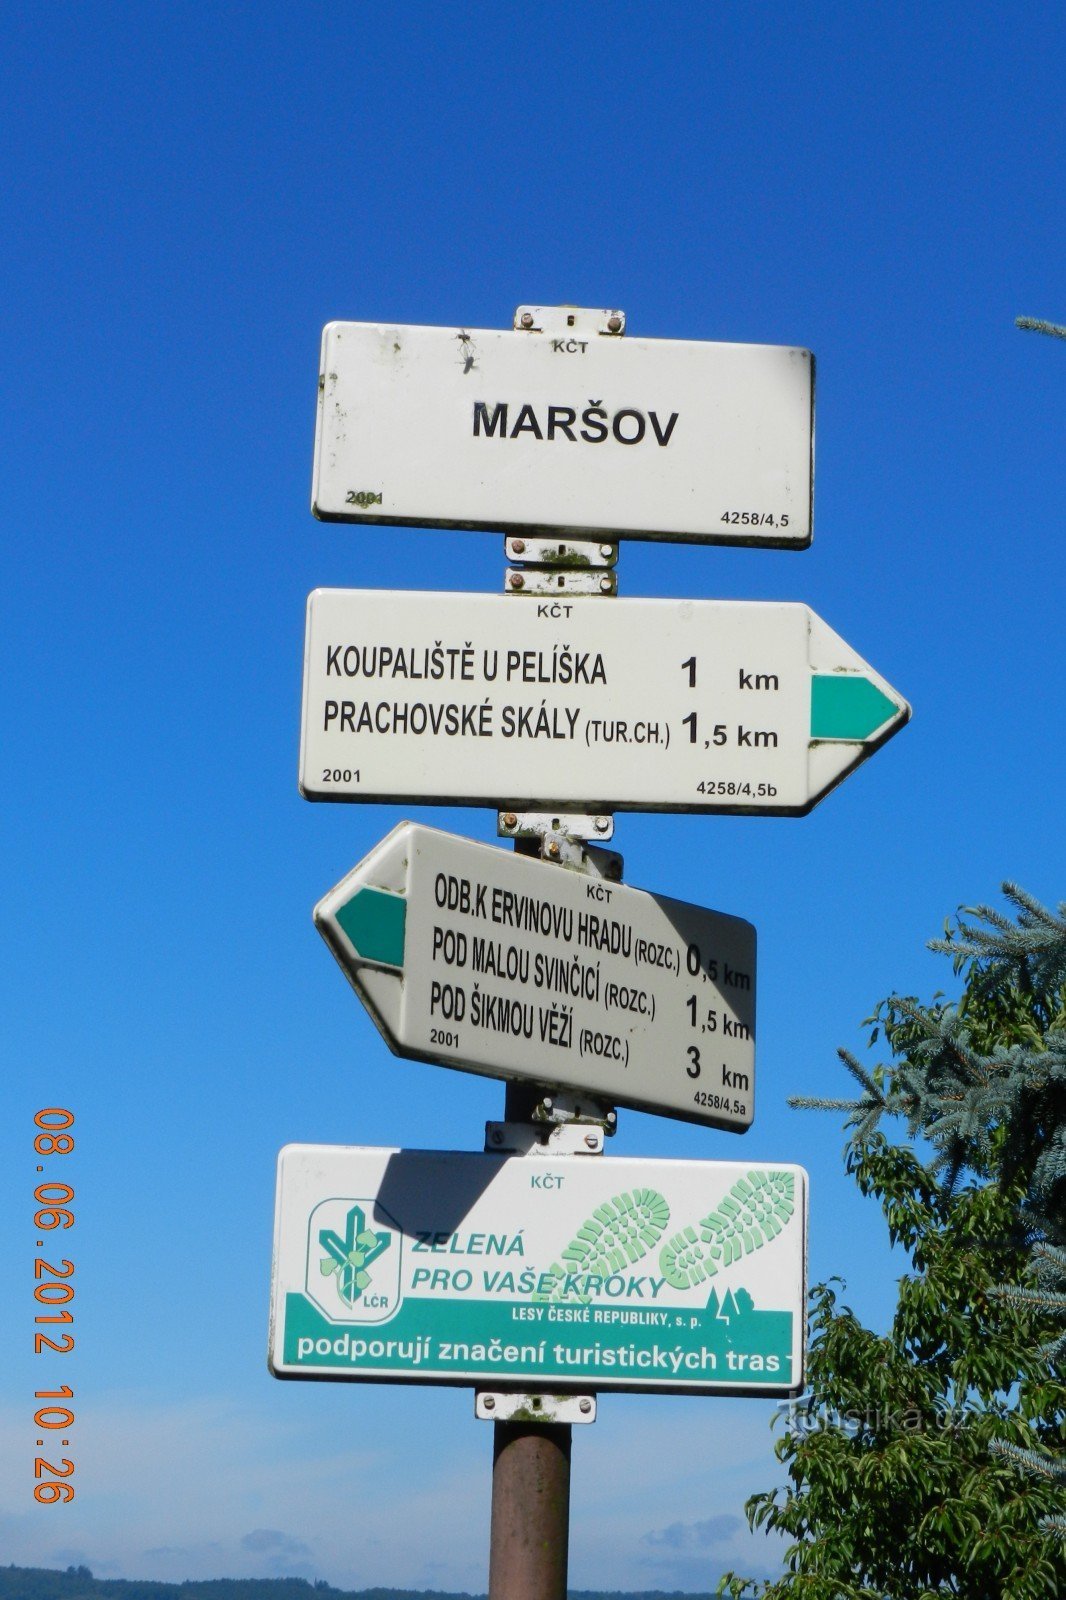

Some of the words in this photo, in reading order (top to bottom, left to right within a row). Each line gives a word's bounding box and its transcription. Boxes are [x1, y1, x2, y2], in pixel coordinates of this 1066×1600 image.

[552, 338, 589, 354] KČT
[472, 400, 679, 447] MARŠOV
[346, 490, 383, 507] 2001
[720, 511, 790, 529] 4258/4,5
[537, 602, 573, 618] KČT
[326, 640, 475, 681] KOUPALIŠTĚ
[483, 649, 498, 681] U
[506, 643, 607, 685] PELÍŠKA
[681, 656, 697, 688] 1
[739, 668, 779, 690] km
[324, 697, 493, 737] PRACHOVSKÉ
[501, 698, 581, 740] SKÁLY
[585, 719, 670, 750] (TUR.CH.)
[682, 711, 727, 750] 1,5
[737, 725, 778, 748] km
[322, 769, 361, 783] 2001
[696, 780, 777, 798] 4258/4,5b
[586, 883, 613, 903] KČT
[491, 887, 573, 942] ERVINOVU
[578, 911, 632, 958] HRADU
[634, 938, 680, 977] (ROZC.)
[686, 944, 718, 983] 0,5
[723, 963, 751, 991] km
[432, 926, 468, 967] POD
[472, 937, 530, 984] MALOU
[534, 952, 600, 1002] SVINČICÍ
[604, 982, 655, 1022] (ROZC.)
[686, 995, 718, 1033] 1,5
[723, 1013, 750, 1041] km
[430, 980, 466, 1022] POD
[470, 982, 534, 1039] ŠIKMOU
[539, 1002, 574, 1049] VĚŽÍ
[579, 1028, 630, 1068] (ROZC.)
[686, 1045, 701, 1079] 3
[722, 1063, 749, 1092] km
[430, 1028, 459, 1048] 2001
[693, 1091, 746, 1116] 4258/4,5a
[530, 1172, 565, 1189] KČT
[411, 1230, 525, 1257] ZELENÁ
[410, 1268, 473, 1292] PRO
[483, 1266, 556, 1295] VAŠE
[562, 1274, 667, 1299] KROKY
[363, 1293, 389, 1309] LČR
[512, 1307, 543, 1322] LESY
[548, 1304, 590, 1323] ČESKÉ
[594, 1310, 672, 1328] REPUBLIKY,
[675, 1316, 688, 1327] s.
[690, 1316, 702, 1330] p.
[297, 1333, 432, 1365] podporují
[438, 1338, 547, 1364] značení
[553, 1343, 717, 1373] turistických
[726, 1350, 780, 1372] tras
